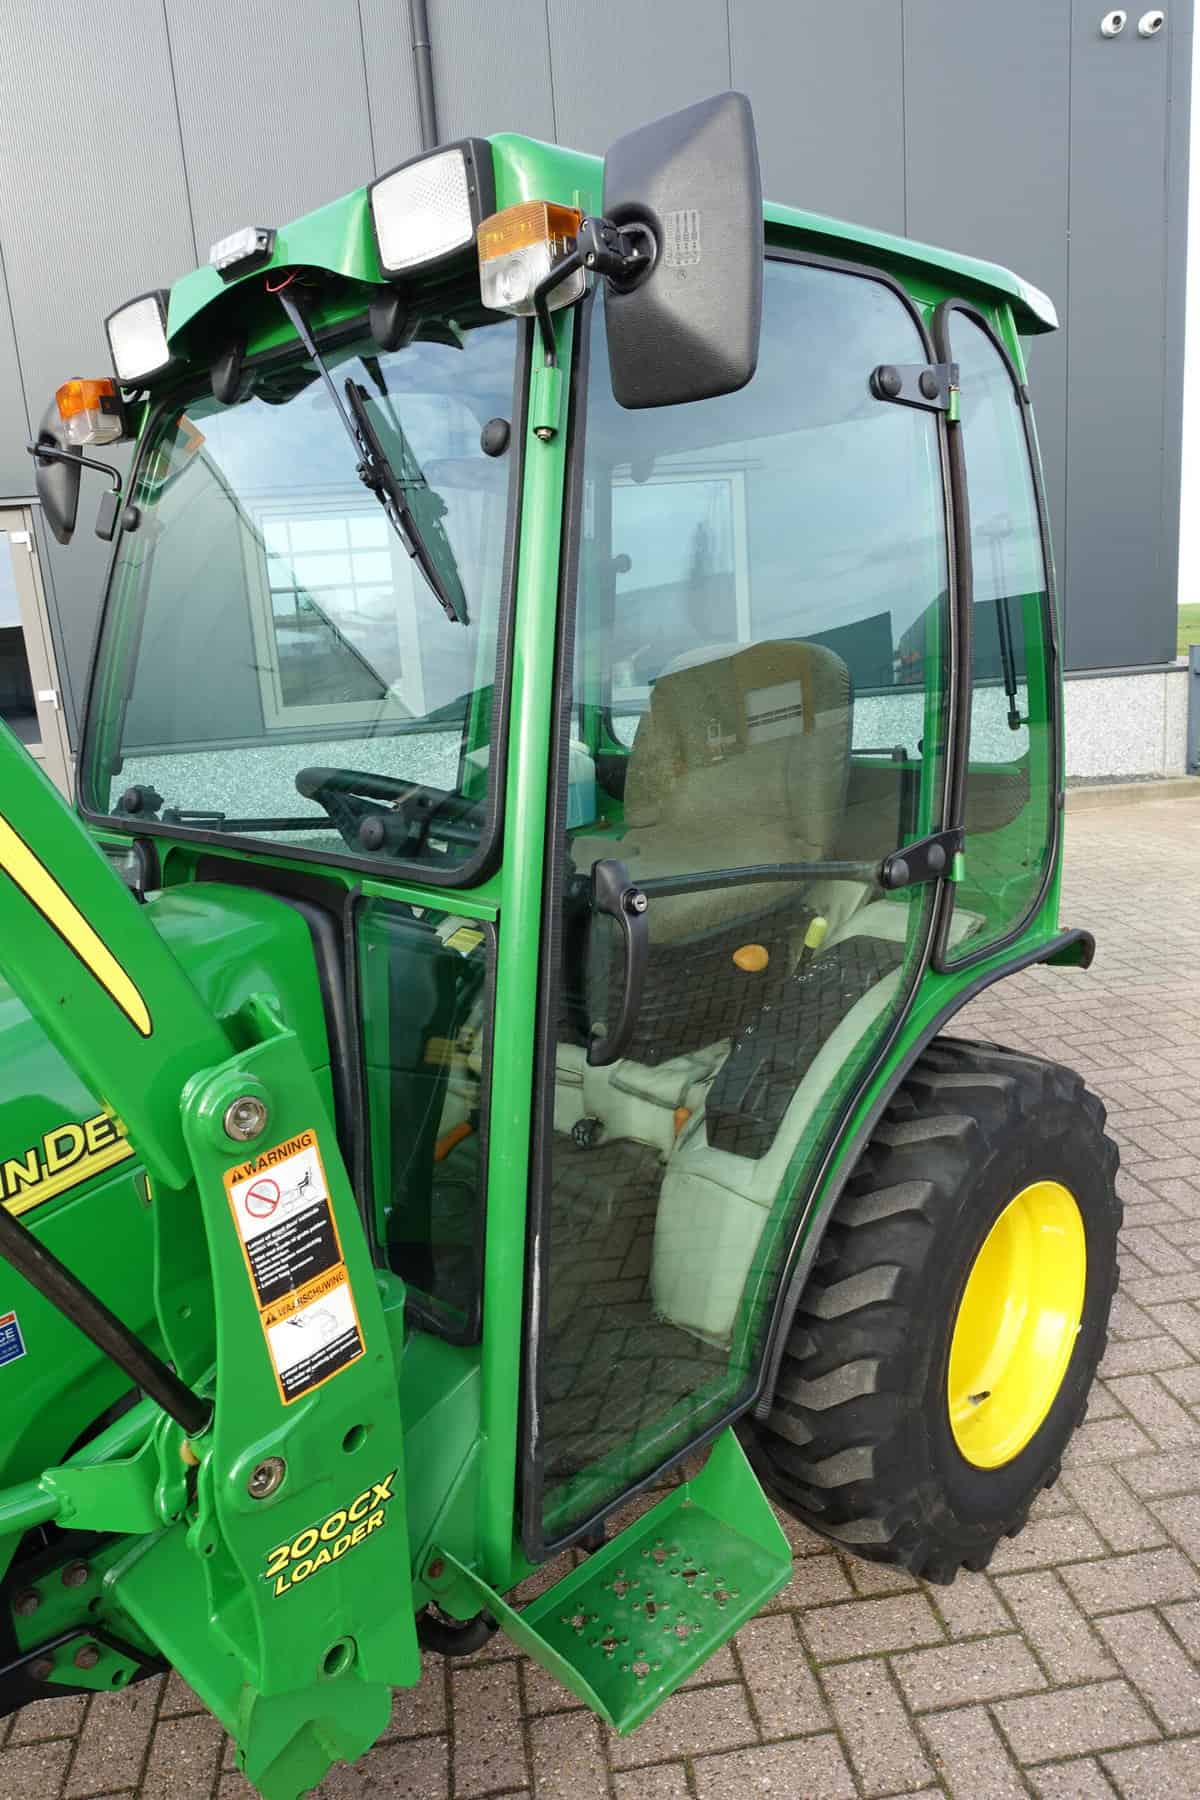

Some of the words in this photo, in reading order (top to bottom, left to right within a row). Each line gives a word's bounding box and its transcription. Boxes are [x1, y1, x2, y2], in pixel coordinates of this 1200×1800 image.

[243, 1133, 313, 1176] WARNING
[264, 1467, 397, 1580] 200CX
[274, 1507, 386, 1597] LOADER
